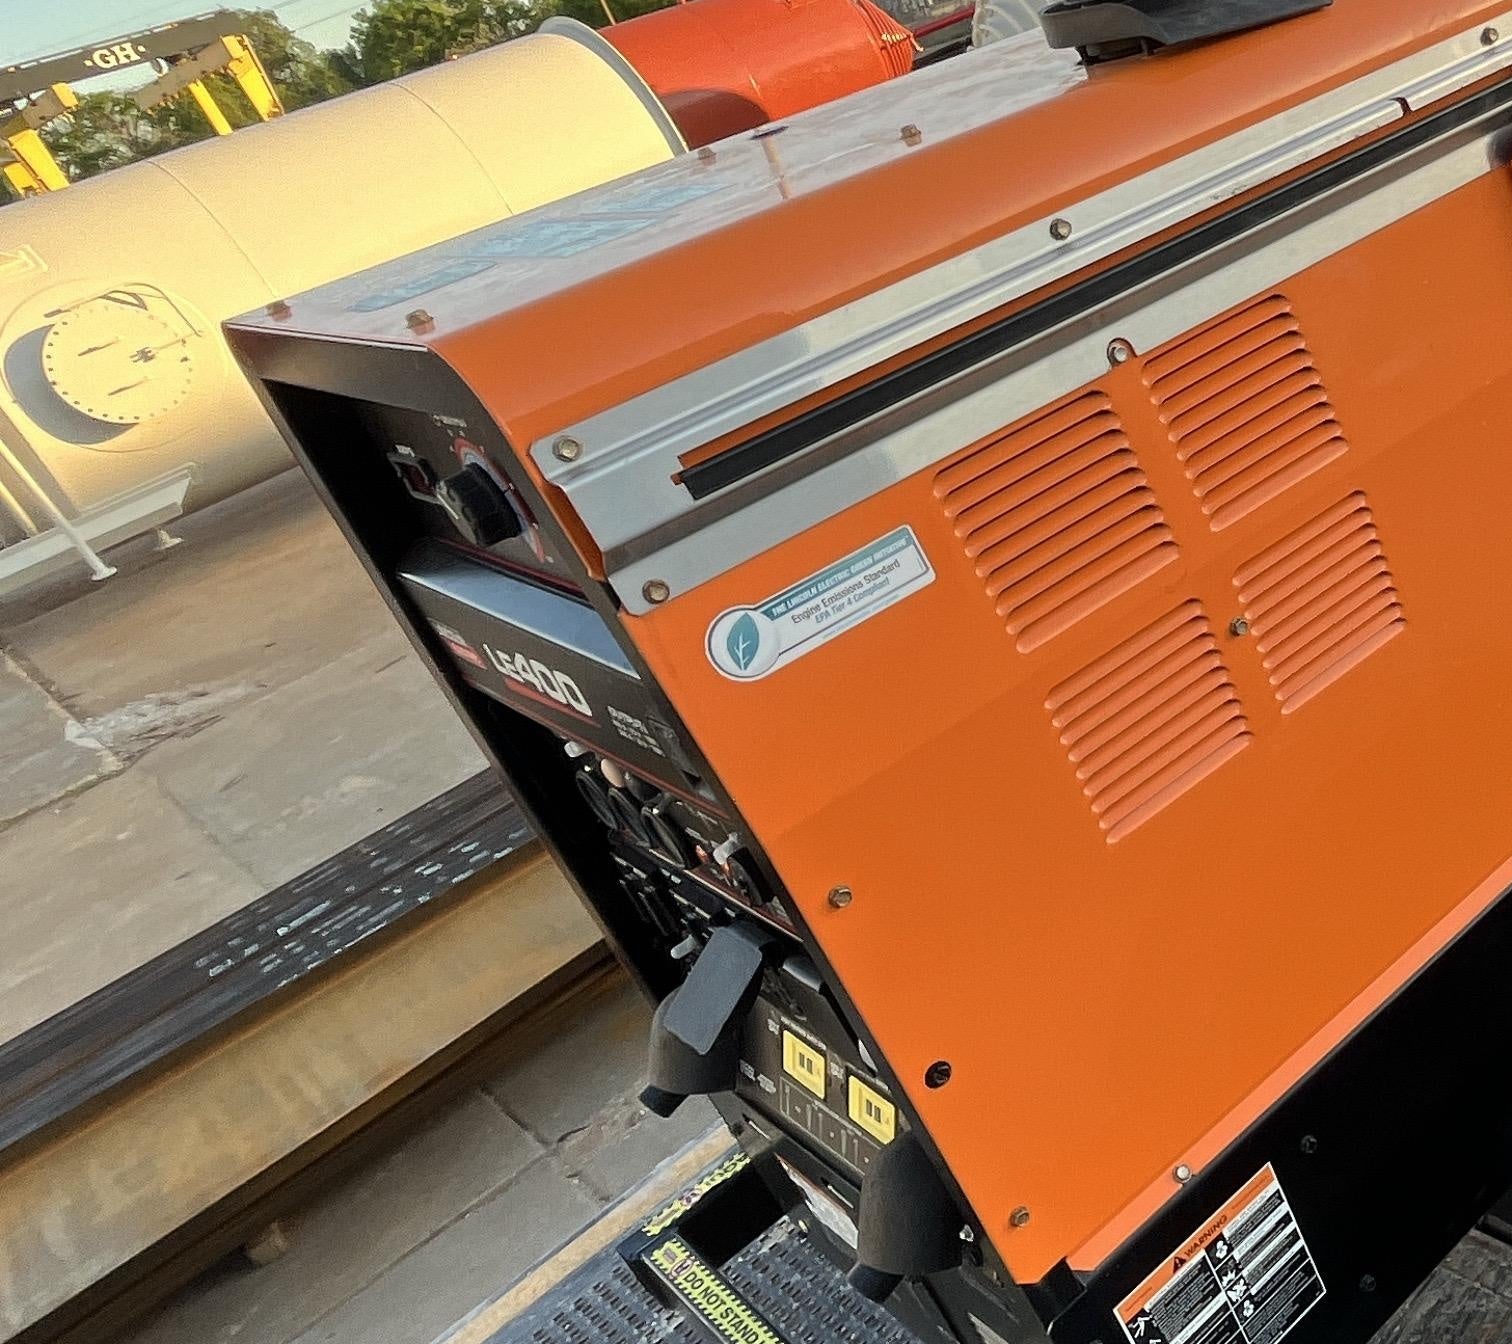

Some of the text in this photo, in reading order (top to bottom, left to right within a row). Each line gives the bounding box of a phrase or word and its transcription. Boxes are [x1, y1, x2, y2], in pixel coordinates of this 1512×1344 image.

[790, 601, 822, 625] Engine
[821, 580, 865, 607] Emissions
[863, 558, 901, 585] Standard
[1183, 1214, 1229, 1257] WARNING
[683, 1271, 705, 1290] DO
[697, 1285, 727, 1311] NOT
[720, 1307, 760, 1344] STAND
